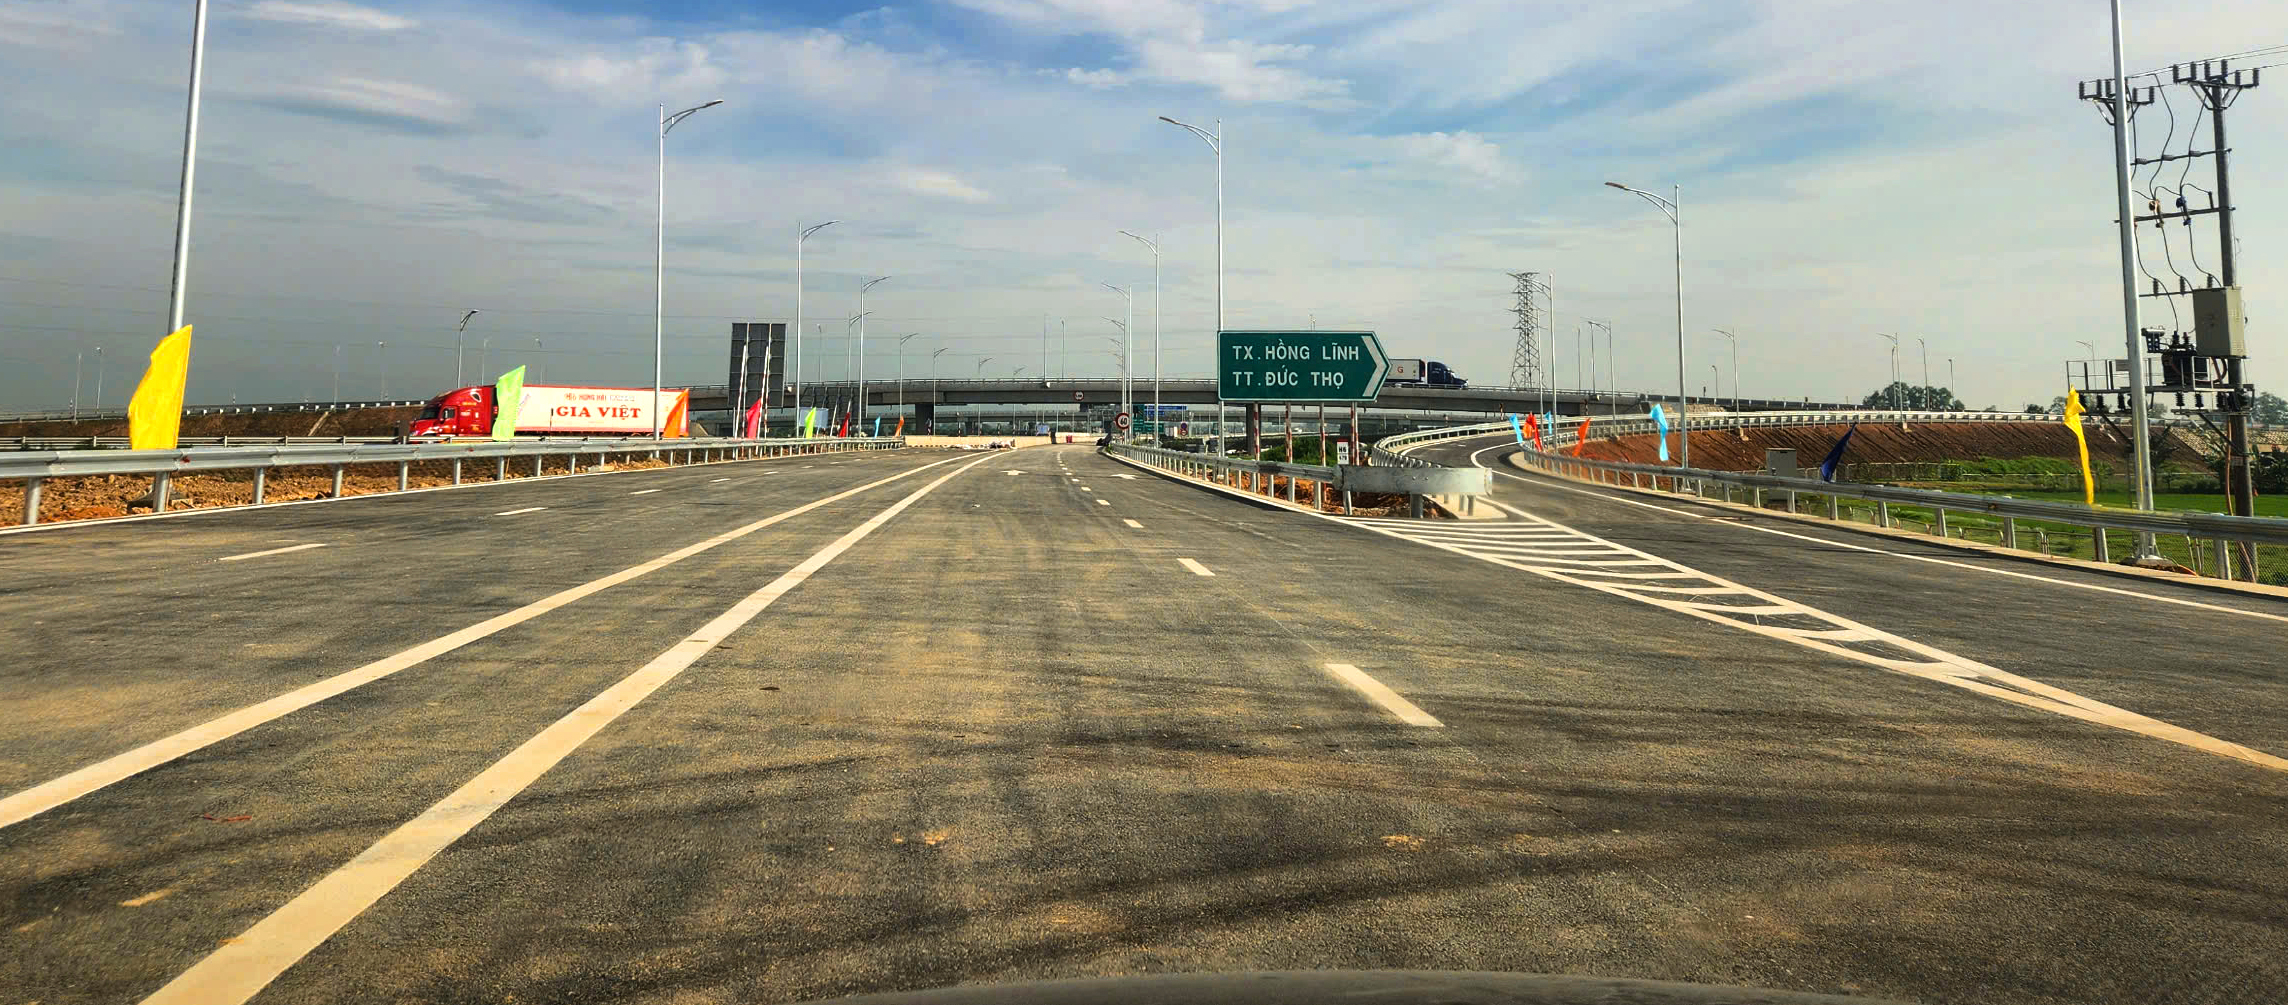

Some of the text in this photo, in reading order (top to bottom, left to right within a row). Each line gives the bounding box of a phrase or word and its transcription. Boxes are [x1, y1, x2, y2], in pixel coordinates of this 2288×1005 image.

[1322, 342, 1359, 361] LĨNH
[1310, 371, 1344, 390] THỌ
[556, 404, 641, 420] GIA VIỆT
[1119, 417, 1128, 426] 60
